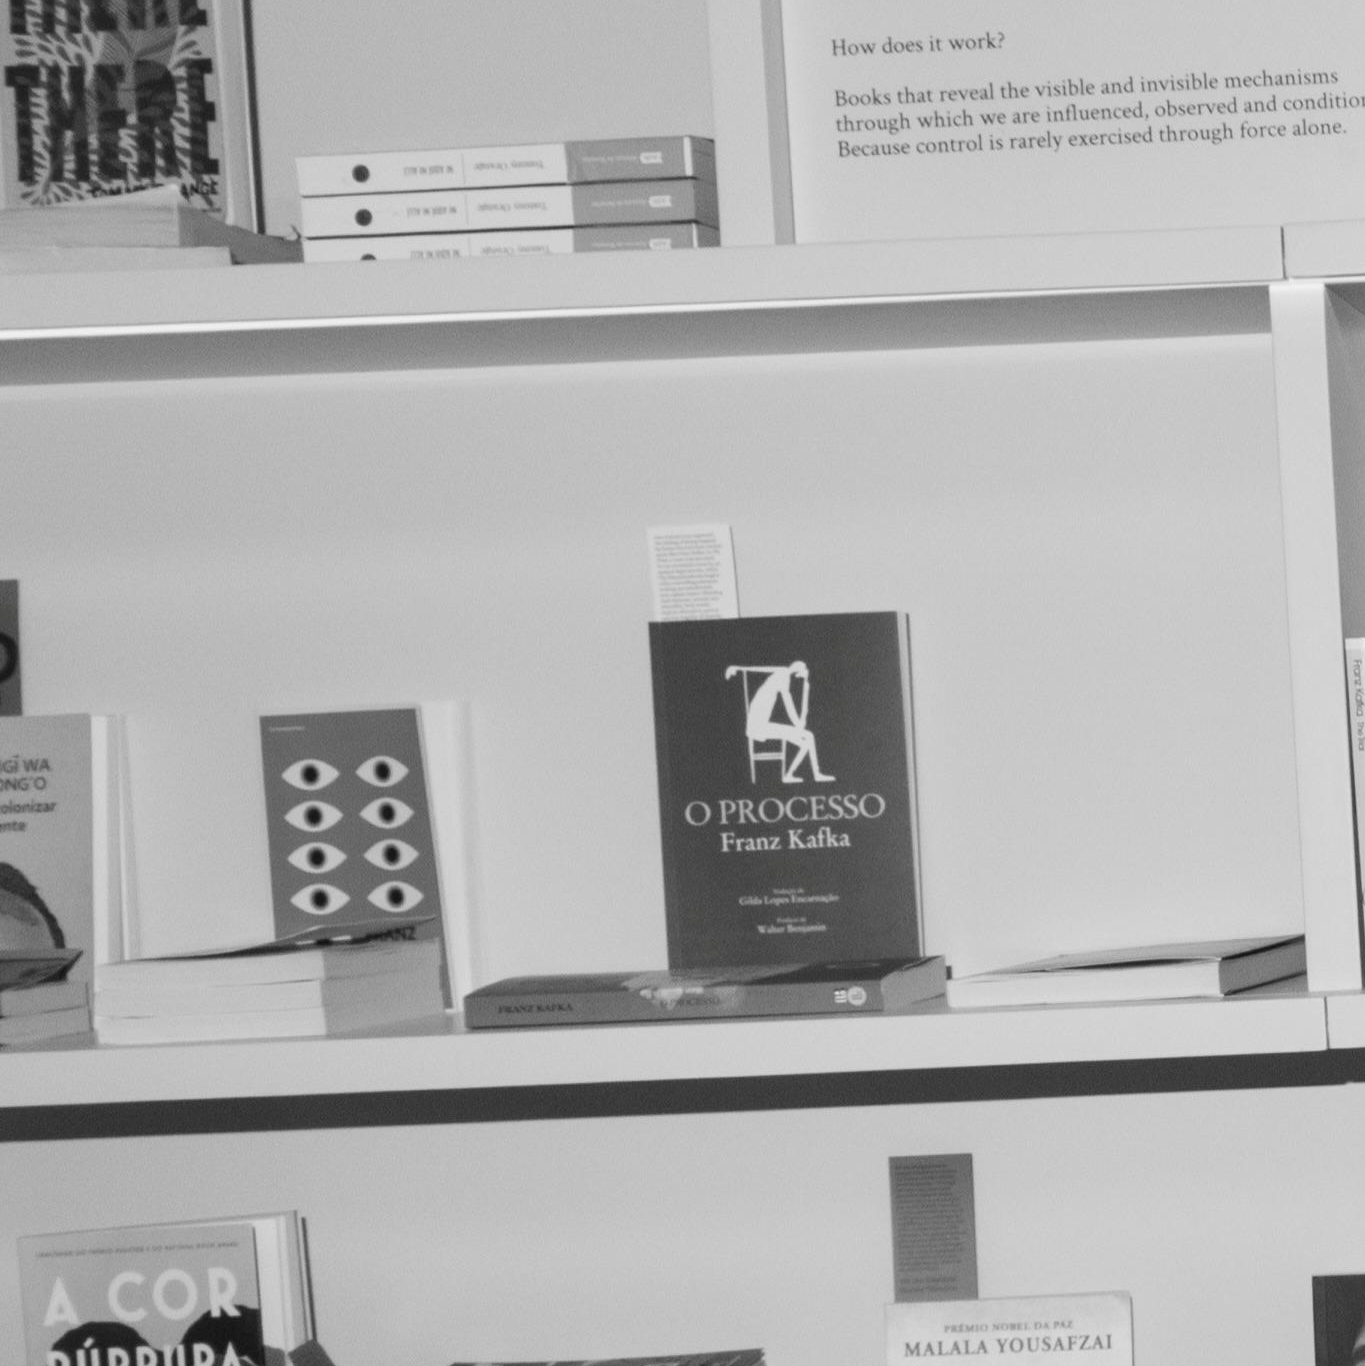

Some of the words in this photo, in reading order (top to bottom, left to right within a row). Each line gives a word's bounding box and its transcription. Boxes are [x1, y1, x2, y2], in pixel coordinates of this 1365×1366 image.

[832, 38, 876, 56] How
[881, 36, 923, 54] does
[929, 35, 942, 52] it
[948, 31, 1005, 50] work?
[835, 88, 891, 107] Books
[897, 86, 933, 104] that
[939, 82, 994, 102] reveal
[1000, 81, 1030, 99] the
[1034, 78, 1095, 97] visible
[1101, 76, 1134, 95] and
[1140, 72, 1218, 92] invisible
[1224, 69, 1338, 88] mechanisms
[836, 112, 911, 135] through
[916, 109, 974, 128] which
[979, 112, 1007, 125] we
[1012, 111, 1040, 124] are
[1046, 100, 1149, 122] influenced,
[1154, 96, 1238, 117] observed
[1243, 94, 1277, 113] and
[838, 140, 911, 158] Because
[916, 133, 983, 154] control
[989, 134, 1004, 150] is
[1009, 130, 1062, 152] rarely
[1068, 125, 1153, 147] exercised
[1159, 122, 1233, 145] through
[1240, 121, 1286, 138] force
[1292, 118, 1346, 136] alone.
[684, 801, 711, 826] O
[719, 792, 886, 824] PROCESSO
[720, 832, 781, 852] Franz
[788, 826, 851, 849] Kafka
[44, 1276, 79, 1326] A
[108, 1266, 242, 1320] COR
[904, 1339, 988, 1357] MALALA
[996, 1334, 1111, 1353] YOUSAFZAI
